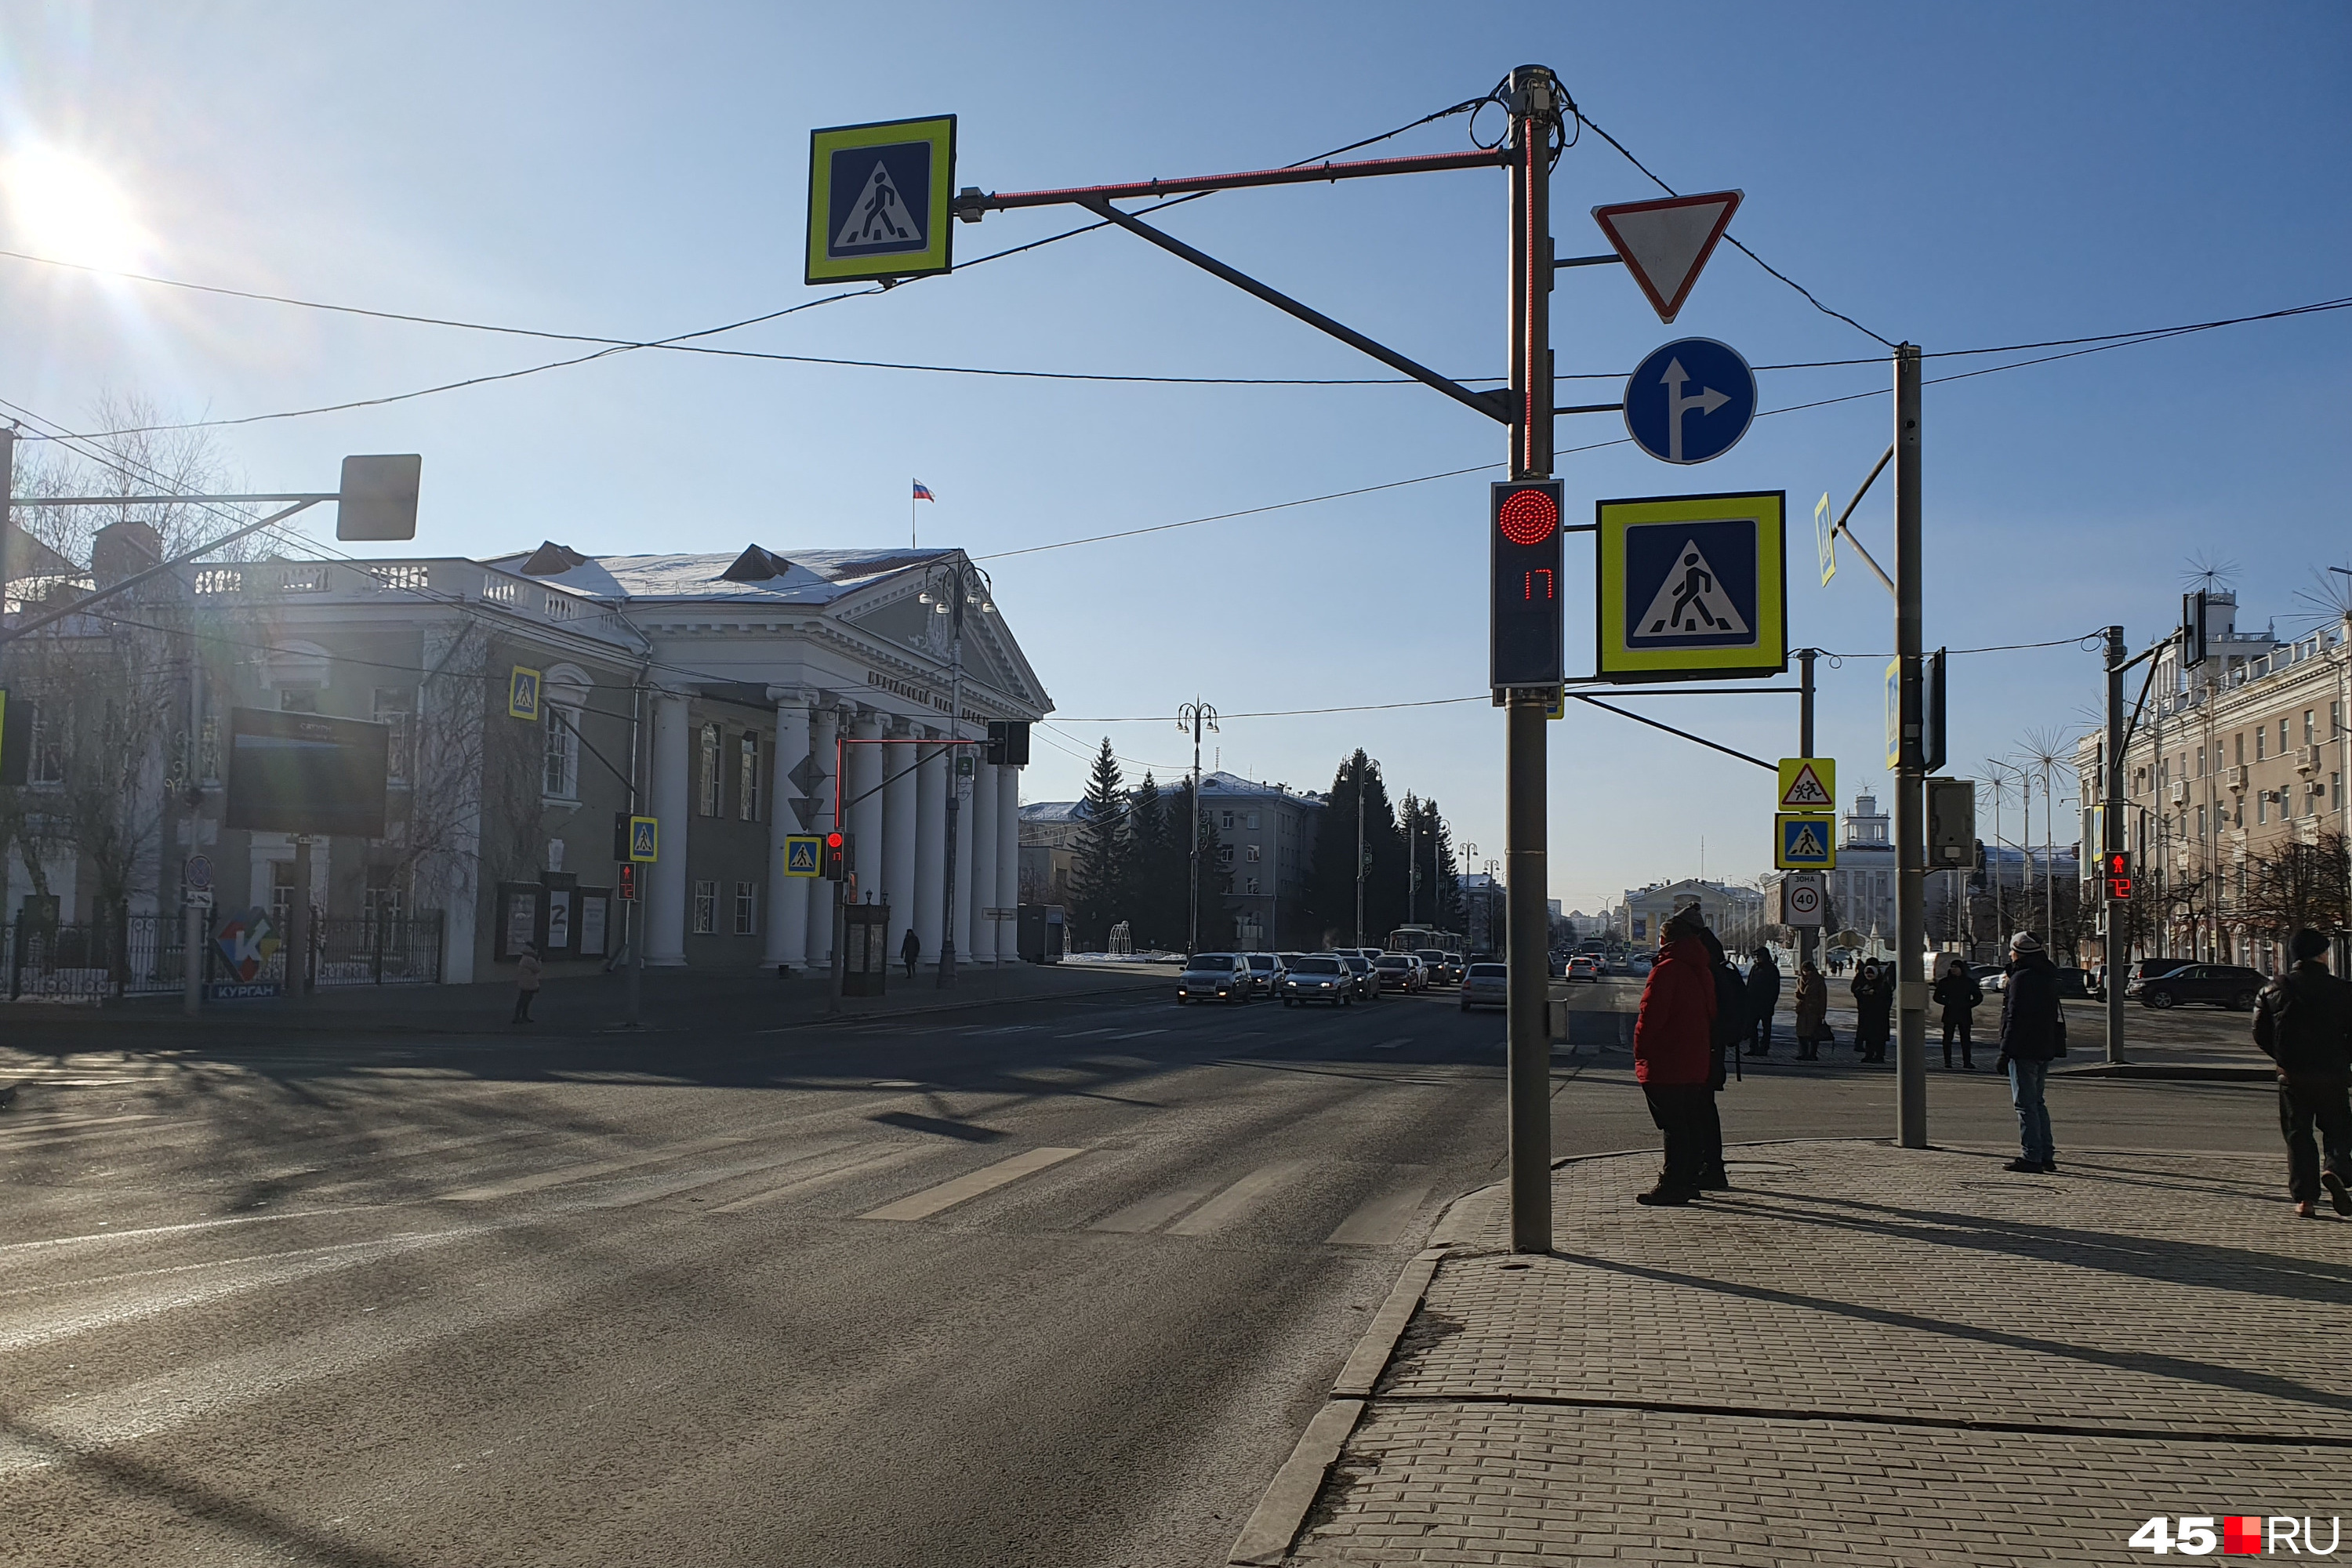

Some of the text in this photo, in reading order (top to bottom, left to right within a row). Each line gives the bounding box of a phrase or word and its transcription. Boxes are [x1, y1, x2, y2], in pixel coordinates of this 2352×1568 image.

[1524, 568, 1553, 601] 17
[620, 883, 633, 898] 72
[2107, 879, 2130, 897] 72
[1796, 894, 1813, 905] 40
[218, 985, 274, 998] КУРГАН
